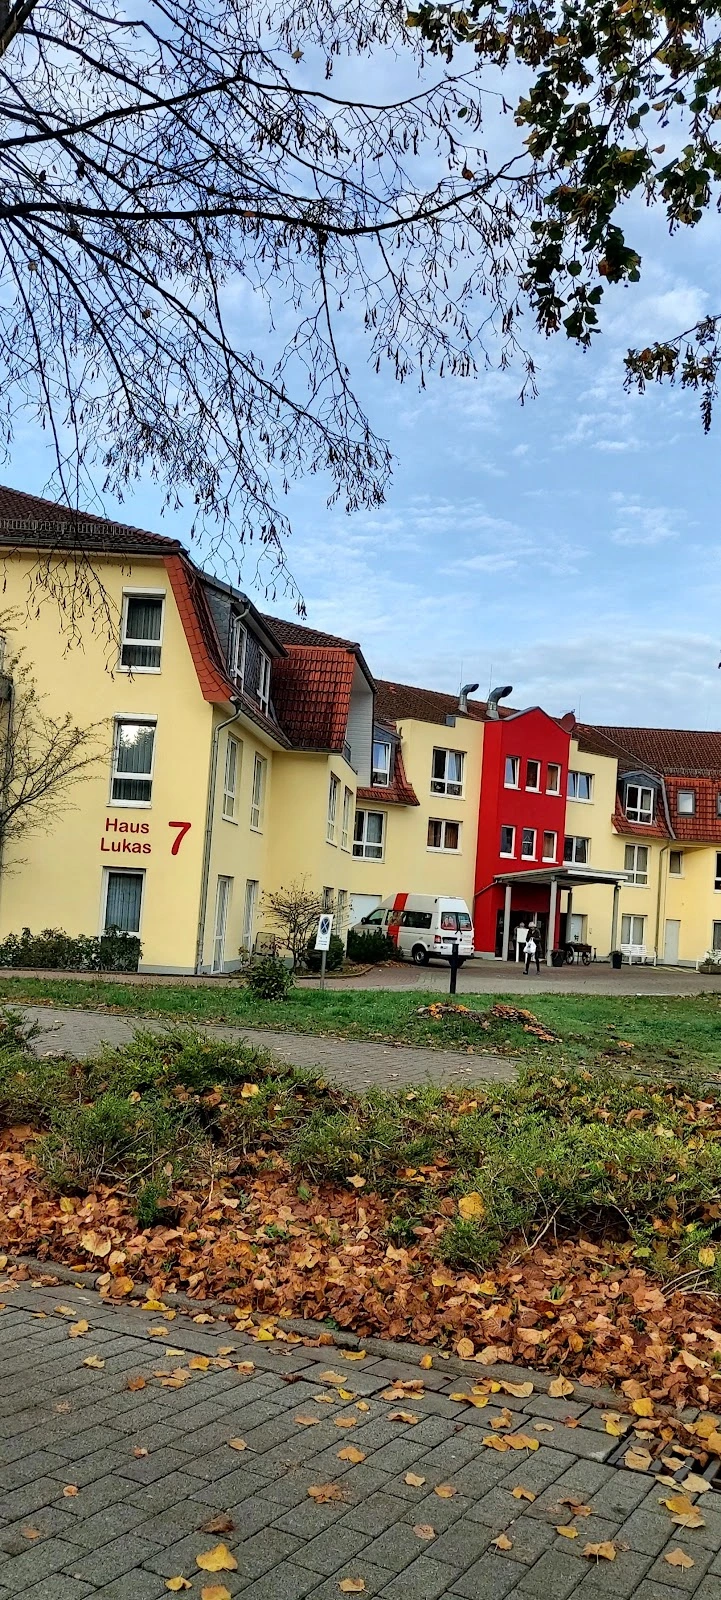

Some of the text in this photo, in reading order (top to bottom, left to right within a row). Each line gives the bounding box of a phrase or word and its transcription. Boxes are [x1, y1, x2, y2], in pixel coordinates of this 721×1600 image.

[105, 817, 150, 834] Haus
[100, 837, 152, 854] Lukas
[168, 821, 192, 856] 7
